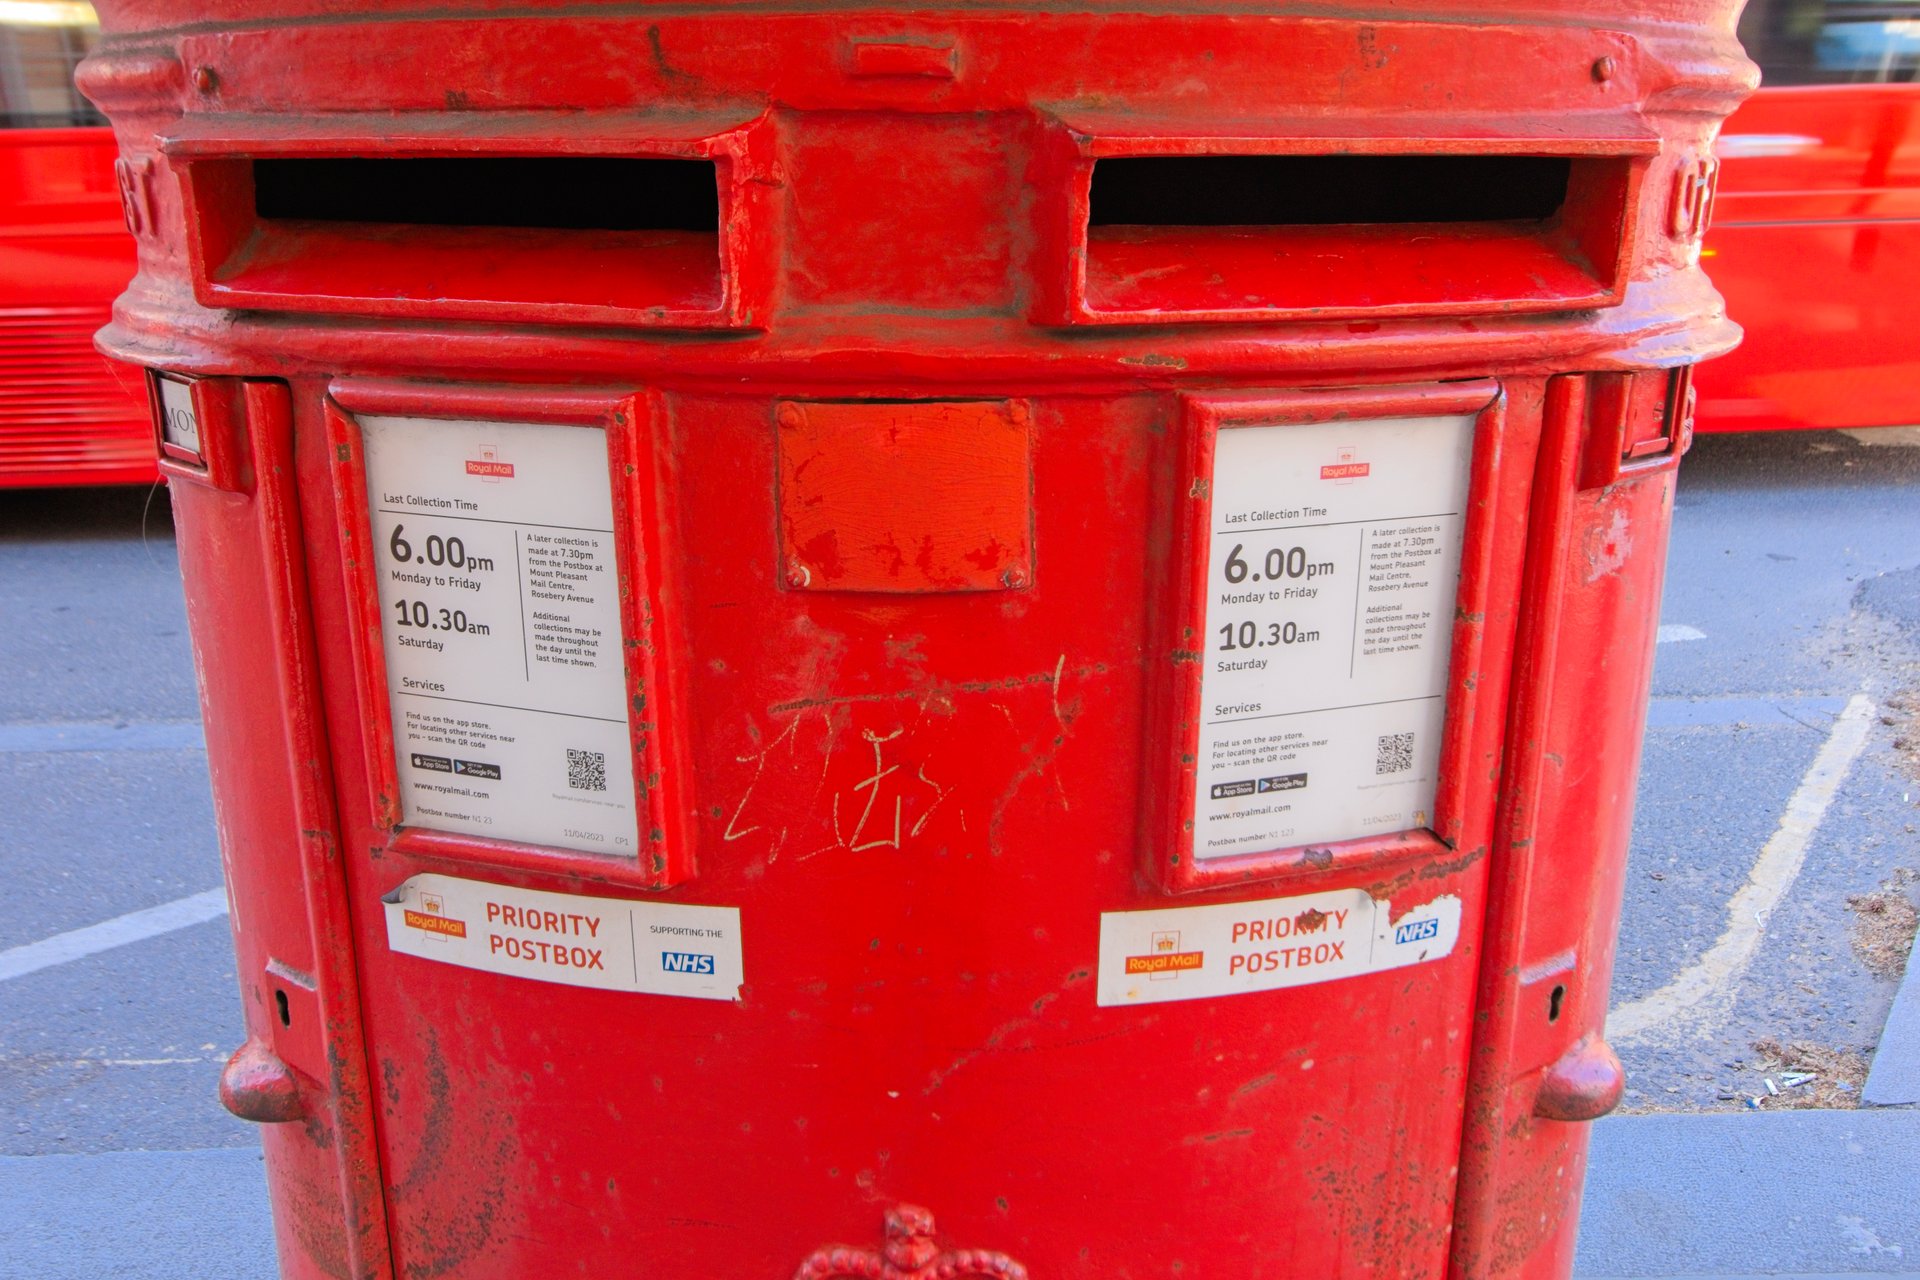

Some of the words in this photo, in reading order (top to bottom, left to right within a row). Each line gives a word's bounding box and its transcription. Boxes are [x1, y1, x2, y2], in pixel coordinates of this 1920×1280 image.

[468, 463, 492, 474] Royal
[493, 465, 512, 474] Mail
[1323, 466, 1347, 477] Royal
[1348, 465, 1367, 475] Mail
[384, 493, 404, 504] Last
[406, 495, 452, 508] Collection
[454, 499, 478, 511] Time
[1226, 513, 1247, 524] Last
[1251, 509, 1299, 522] Collection
[1302, 507, 1327, 517] Time
[1399, 525, 1432, 535] collection
[1434, 524, 1440, 532] is
[534, 534, 552, 543] later
[554, 537, 590, 546] collection
[592, 539, 598, 547] is
[1403, 537, 1434, 547] 7.30pm
[390, 524, 494, 573] 6.00pm
[561, 548, 594, 560] 7.30pm
[1390, 551, 1402, 559] the
[1404, 549, 1432, 557] Postbox
[529, 557, 547, 566] from
[549, 560, 561, 568] the
[563, 561, 593, 570] Postbox
[1225, 544, 1334, 584] 6.00pm
[1370, 563, 1393, 571] Mount
[1395, 560, 1426, 568] Pleasant
[392, 570, 431, 587] Monday
[435, 576, 445, 586] to
[449, 576, 481, 592] Friday
[530, 568, 554, 578] Mount
[556, 571, 588, 581] Pleasant
[531, 579, 546, 587] Mail
[548, 581, 575, 591] Centre,
[1369, 584, 1401, 592] Rosebery
[1402, 581, 1429, 589] Avenue
[531, 590, 565, 601] Rosebery
[567, 594, 594, 604] Avenue
[1221, 592, 1265, 605] Monday
[1269, 591, 1280, 600] to
[1284, 587, 1318, 599] Friday
[1366, 604, 1402, 613] Additional
[395, 599, 490, 636] 10.30am
[533, 611, 570, 622] Additional
[1366, 615, 1403, 624] collections
[534, 623, 572, 633] collections
[574, 628, 590, 636] may
[1365, 626, 1384, 634] made
[1387, 622, 1426, 632] throughout
[535, 634, 555, 642] made
[557, 636, 598, 647] throughout
[1220, 621, 1319, 651] 10.30am
[1393, 634, 1409, 642] until
[398, 635, 444, 652] Saturday
[536, 644, 547, 652] the
[550, 645, 563, 654] day
[584, 649, 596, 657] the
[536, 654, 550, 662] last
[552, 656, 568, 664] time
[571, 659, 596, 668] shown.
[1217, 658, 1268, 672] Saturday
[402, 677, 445, 692] Services
[1215, 703, 1261, 716] Services
[406, 712, 421, 720] Find
[443, 717, 454, 725] the
[471, 722, 491, 730] store.
[407, 721, 418, 729] For
[420, 723, 447, 734] locating
[449, 728, 468, 736] other
[469, 732, 497, 740] services
[458, 738, 468, 746] QR
[470, 741, 486, 749] code
[1213, 740, 1229, 749] Find
[1268, 735, 1282, 743] app
[1227, 748, 1256, 757] locating
[1258, 745, 1279, 753] other
[1280, 742, 1310, 751] services
[422, 761, 434, 769] App
[1212, 763, 1225, 771] you
[1267, 754, 1277, 762] QR
[467, 767, 487, 776] Google
[487, 768, 499, 778] Play
[414, 783, 489, 799] www.royalmail.com
[1223, 788, 1236, 796] App
[1237, 786, 1253, 794] Store
[1271, 780, 1292, 789] Google
[1293, 779, 1305, 787] Play
[416, 806, 443, 816] Postbox
[444, 812, 470, 821] number
[1209, 805, 1291, 821] www.royalmail.com
[564, 829, 604, 842] 11/04/2023
[615, 837, 629, 846] CP1
[1208, 838, 1236, 847] Postbox
[1239, 834, 1266, 842] number
[407, 914, 437, 929] Royal
[439, 919, 463, 934] Mail
[486, 902, 600, 938] PRIORITY
[649, 925, 704, 937] SUPPORTING
[706, 929, 723, 938] THE
[1397, 919, 1437, 944] NHS
[490, 934, 604, 970] POSTBOX
[1229, 940, 1345, 976] POSTBOX
[663, 952, 713, 974] NHS
[1129, 957, 1167, 971] Royal
[1169, 953, 1200, 967] Mail
